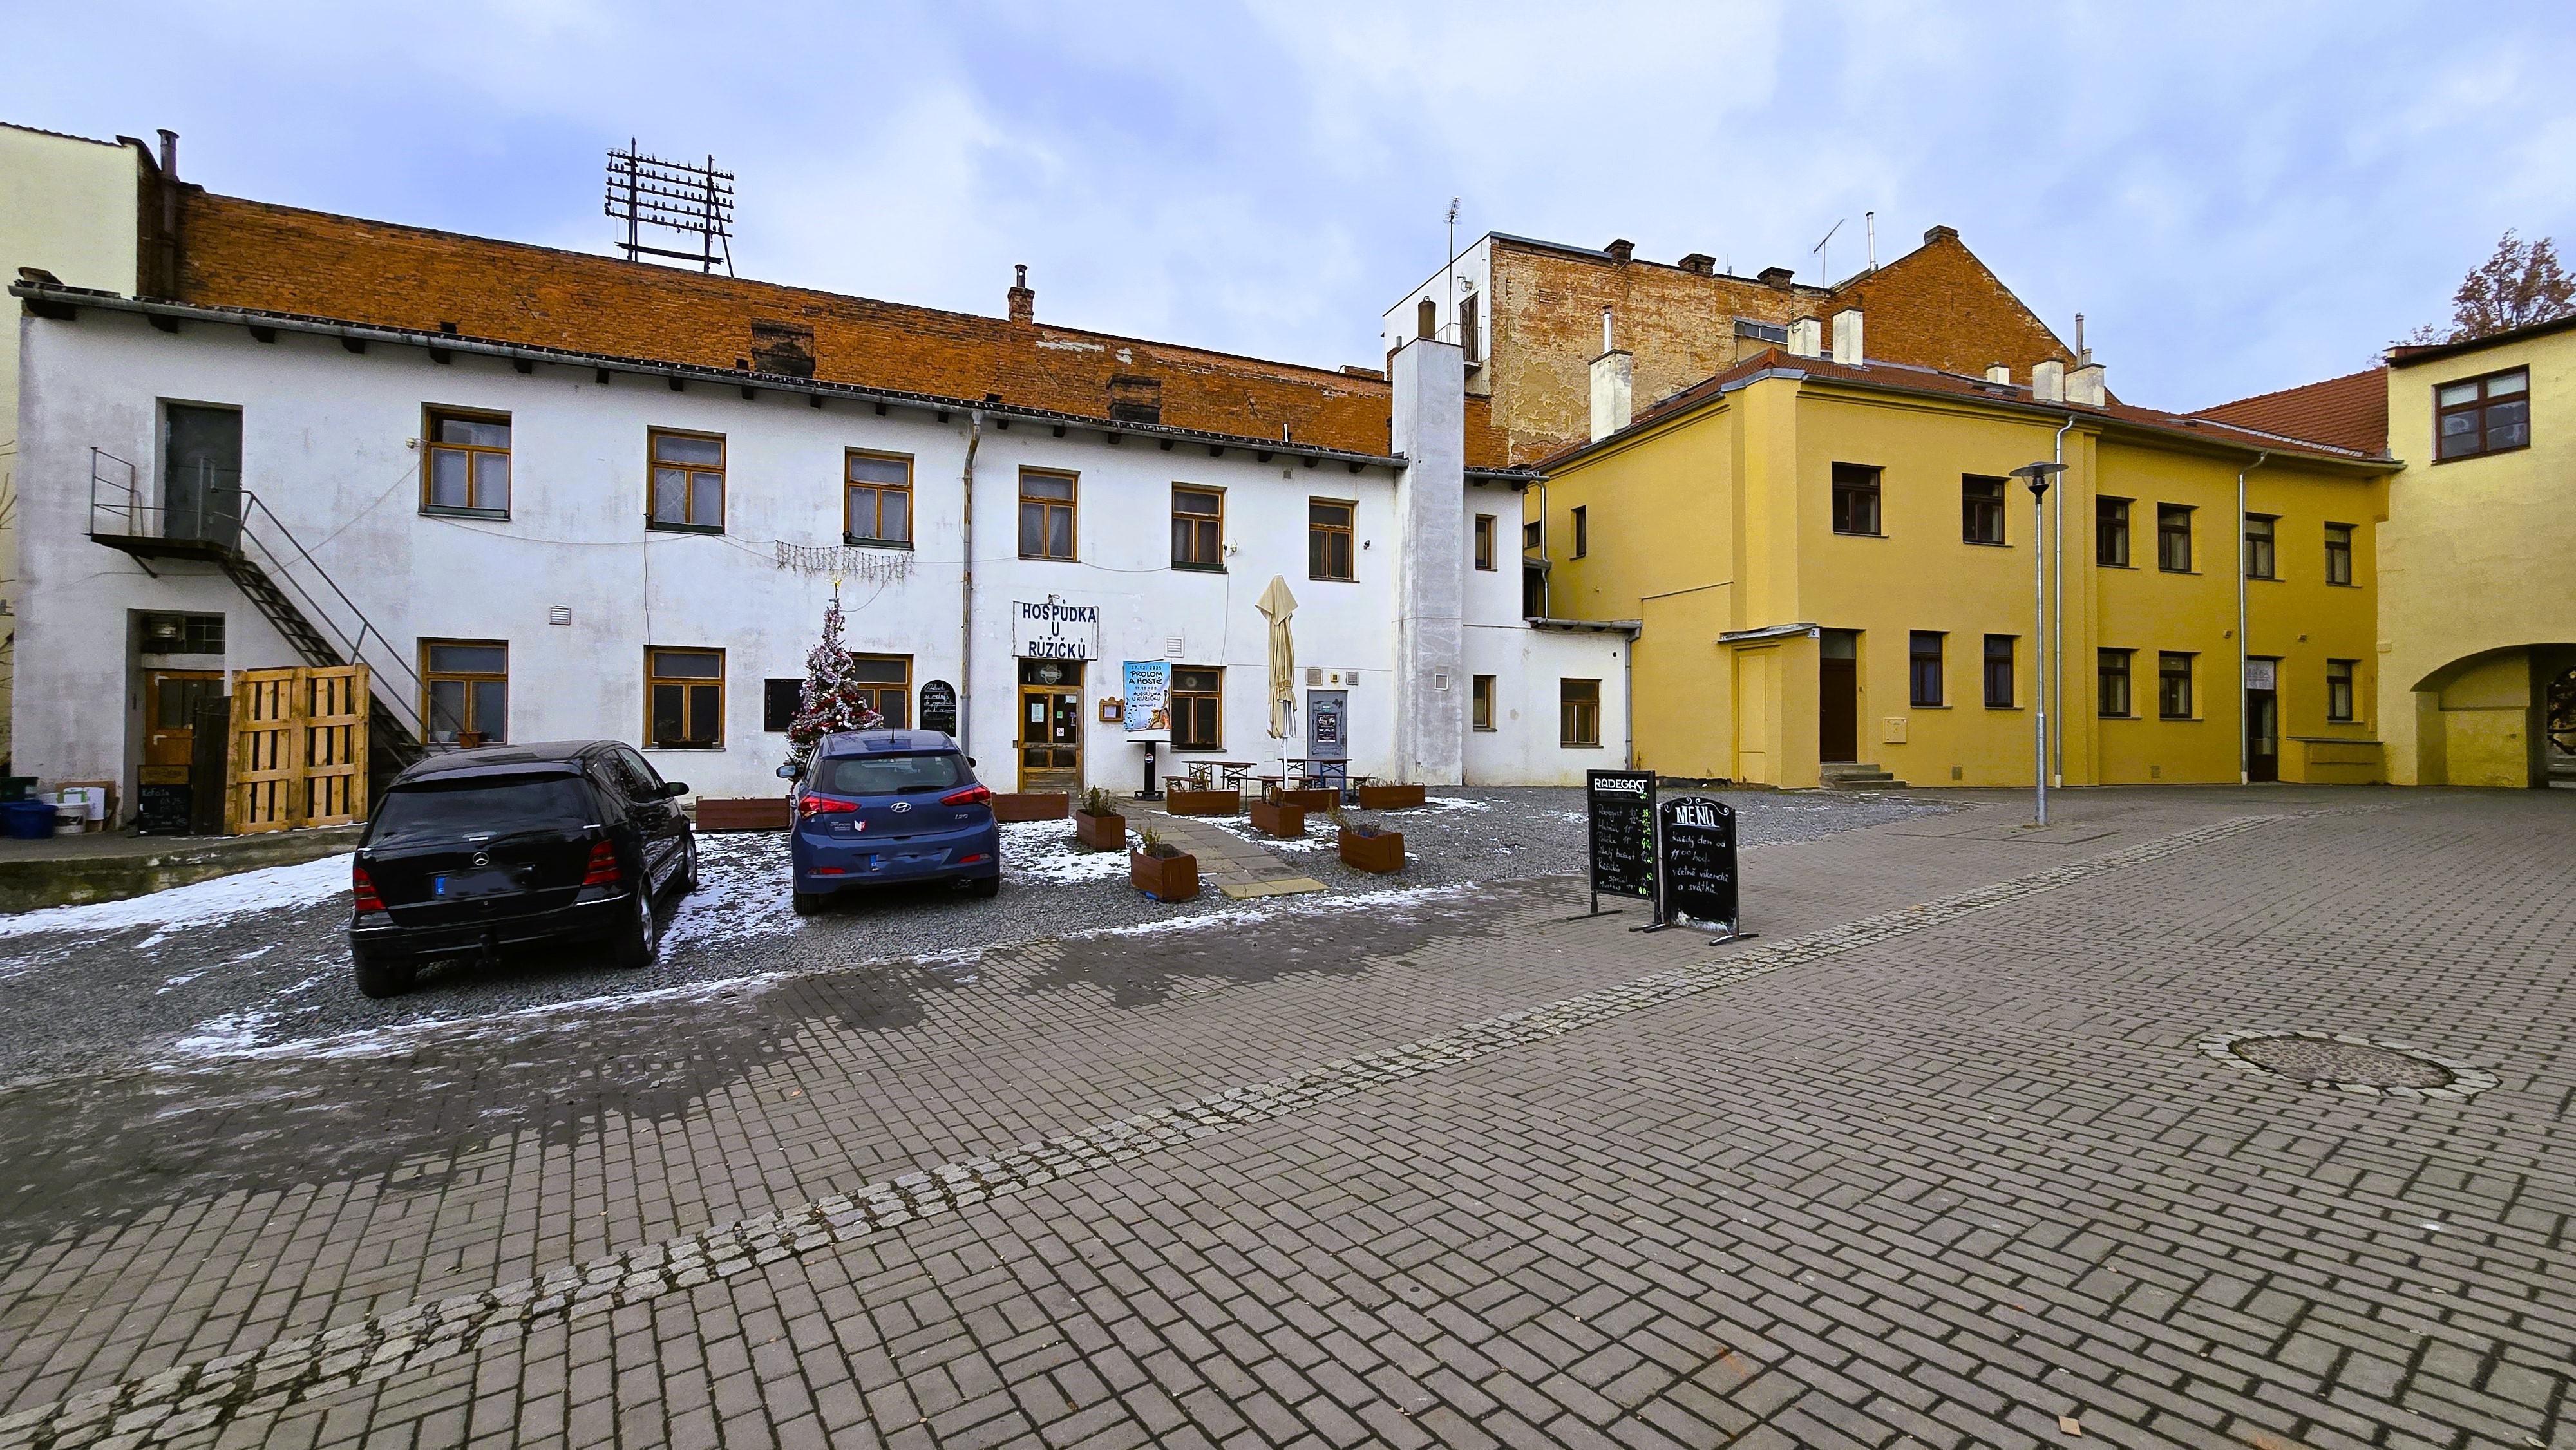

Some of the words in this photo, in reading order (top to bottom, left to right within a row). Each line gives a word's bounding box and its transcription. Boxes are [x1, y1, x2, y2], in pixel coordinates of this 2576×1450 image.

[1023, 599, 1097, 623] HOSPŮDKA
[1052, 621, 1059, 637] U
[1028, 636, 1086, 659] RŮŽIČKŮ
[1594, 778, 1647, 794] RADEGAST
[1675, 805, 1718, 827] MENU
[1697, 835, 1712, 845] den
